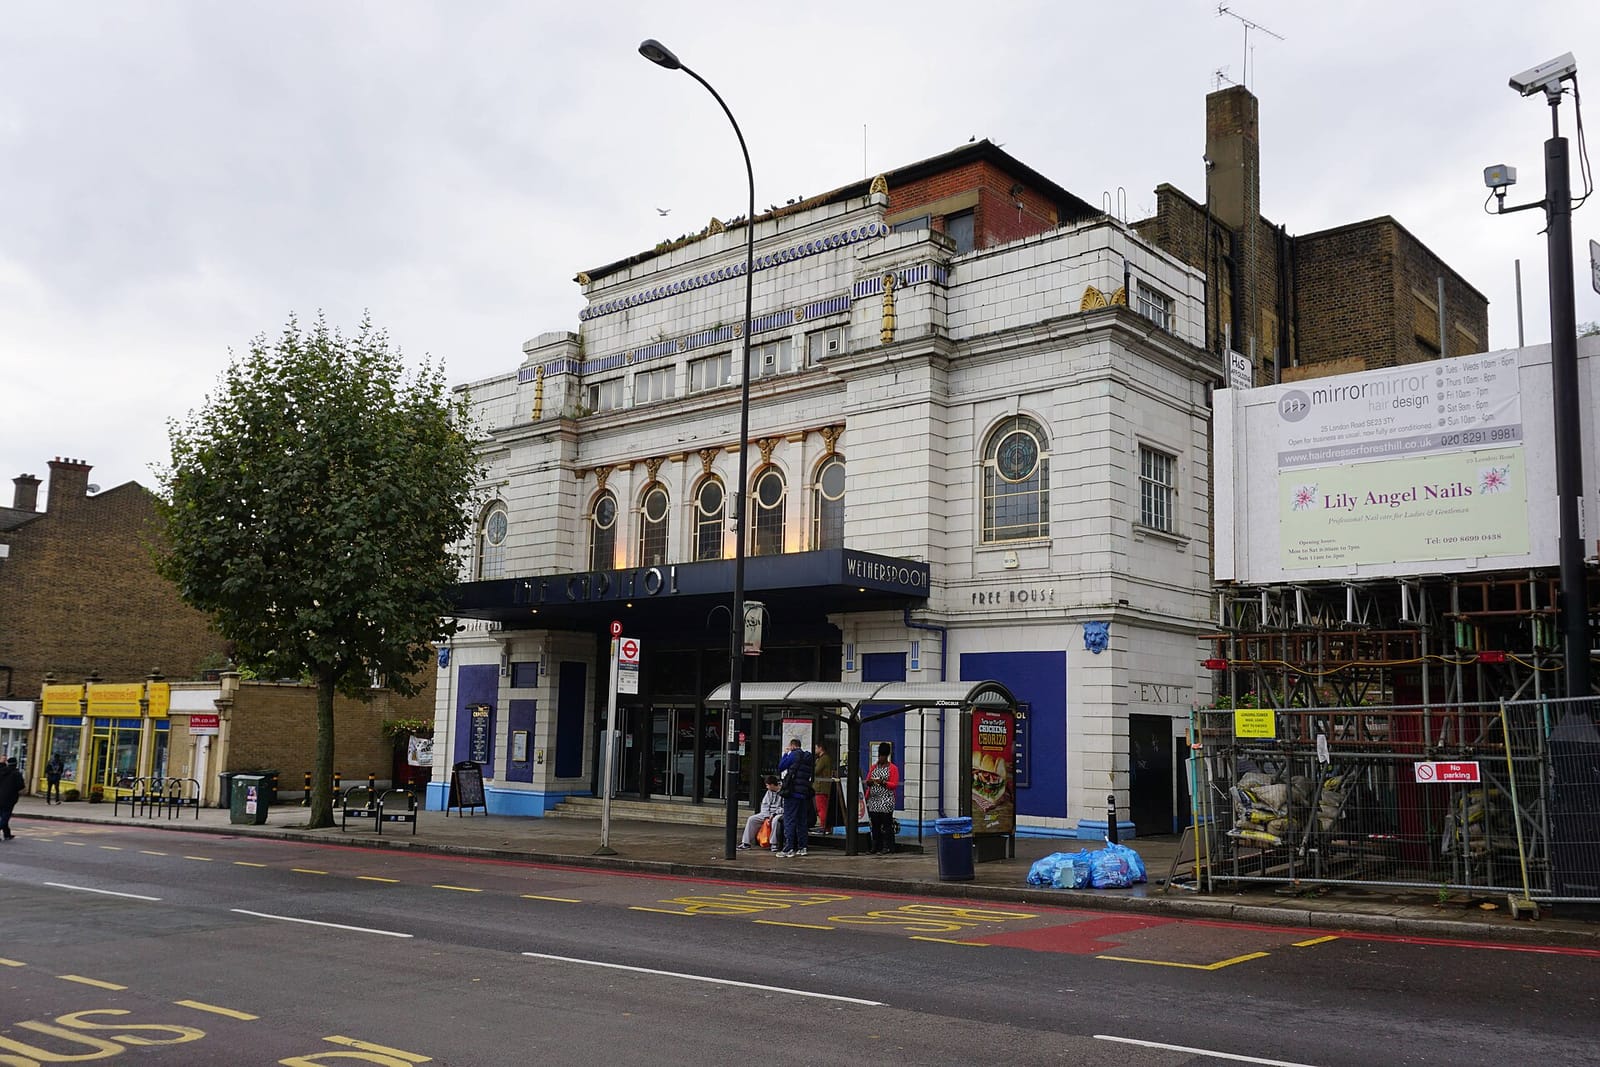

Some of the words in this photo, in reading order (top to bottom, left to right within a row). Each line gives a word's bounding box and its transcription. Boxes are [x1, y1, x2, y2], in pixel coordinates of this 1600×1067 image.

[1463, 376, 1478, 384] 10am
[1456, 390, 1470, 398] 10am
[1368, 399, 1388, 411] hair
[1392, 395, 1429, 409] design
[1330, 422, 1350, 432] London
[1350, 420, 1366, 429] Road
[1461, 415, 1476, 424] 10am
[1441, 434, 1460, 446] 020
[1462, 432, 1486, 443] 8291
[1491, 428, 1515, 440] 9981
[1324, 493, 1358, 512] Lily
[1363, 486, 1417, 508] Angel
[1423, 482, 1473, 500] Nails
[847, 558, 928, 589] WETHERSPOON
[972, 591, 1001, 605] FREE
[1010, 587, 1055, 604] HOUSE
[614, 623, 620, 633] D
[1141, 684, 1181, 703] EXIT
[978, 734, 1006, 746] CHORIZO
[0, 1008, 206, 1067] US
